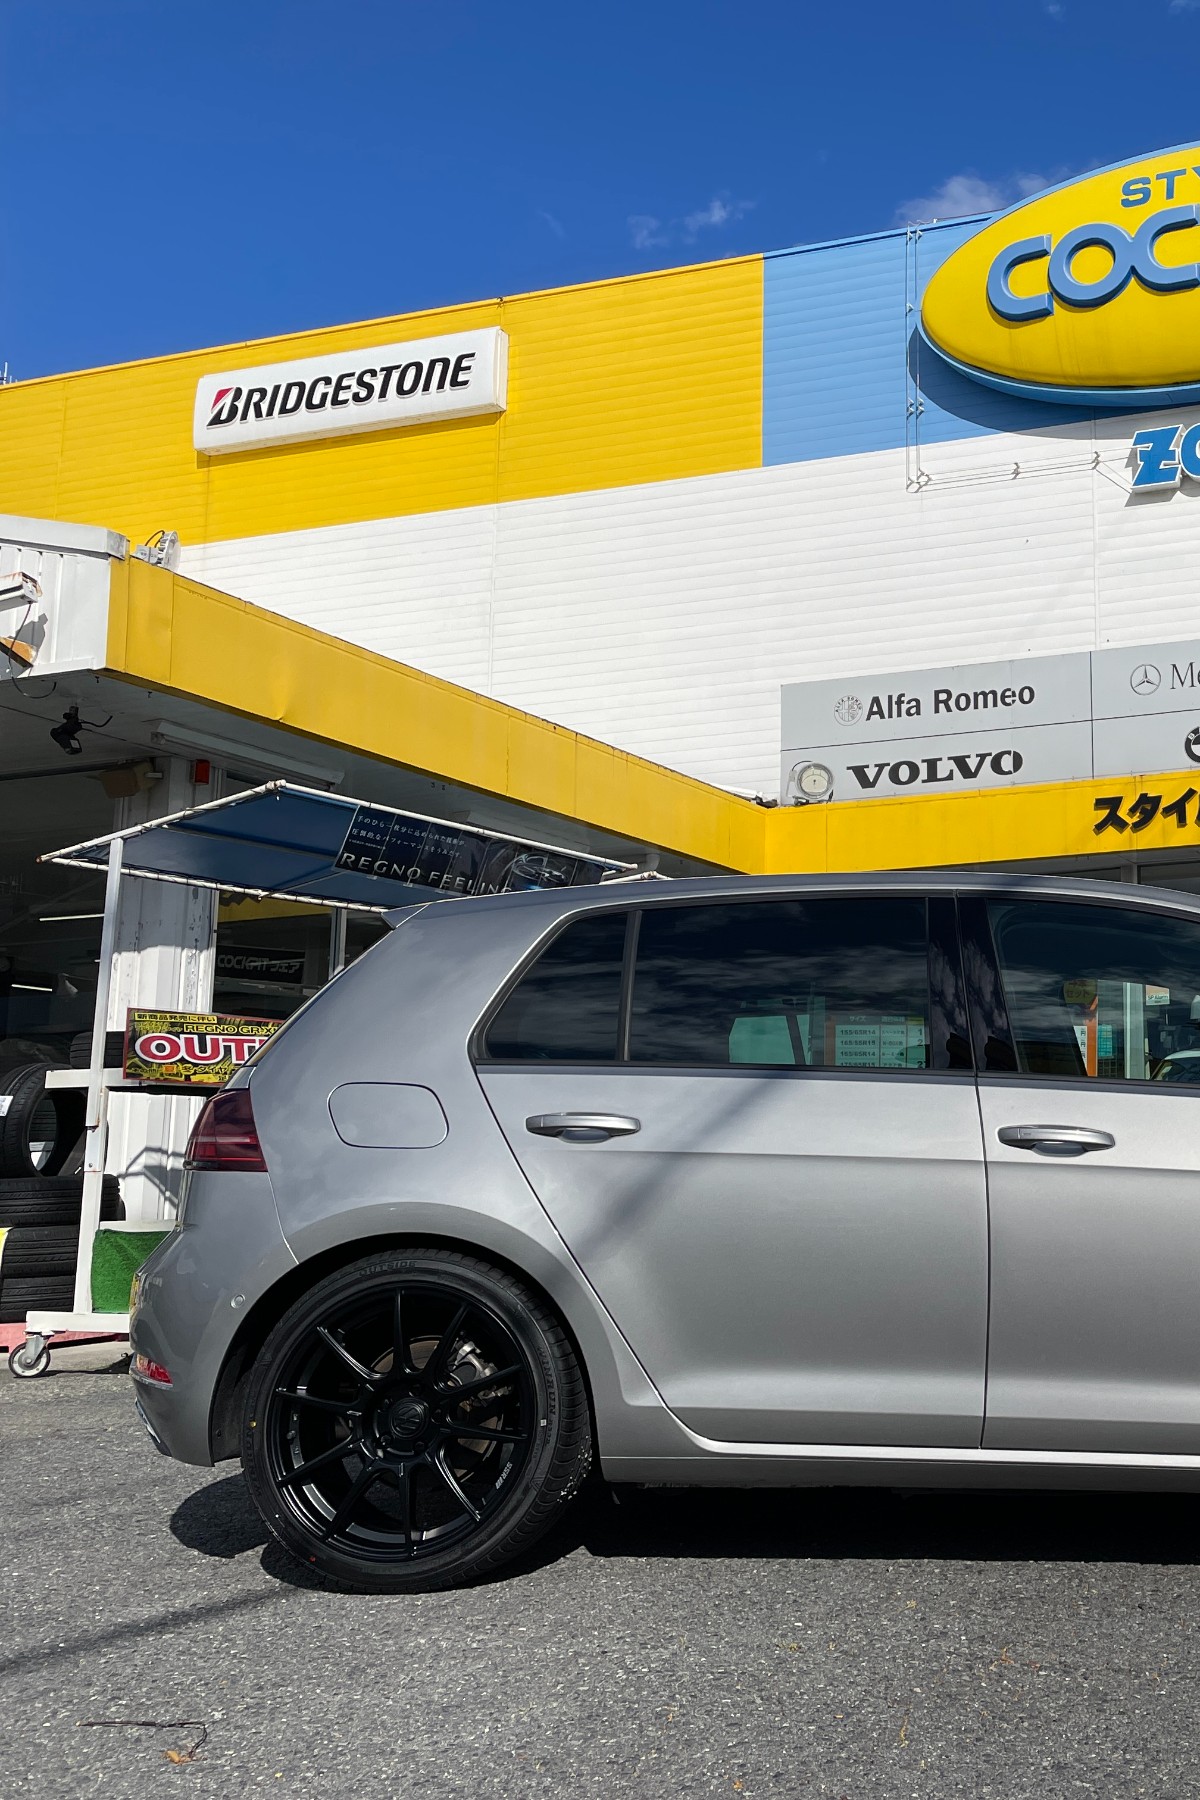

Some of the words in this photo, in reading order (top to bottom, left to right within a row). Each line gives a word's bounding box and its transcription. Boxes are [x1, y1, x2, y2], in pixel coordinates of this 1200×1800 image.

[206, 351, 476, 428] BRIDGESTONE
[865, 692, 921, 722] Alfa
[933, 685, 1035, 715] Romeo
[846, 750, 1023, 790] VOLVO
[340, 852, 421, 880] REGNO
[184, 1023, 237, 1034] REGNO
[135, 1033, 268, 1064] OUT
